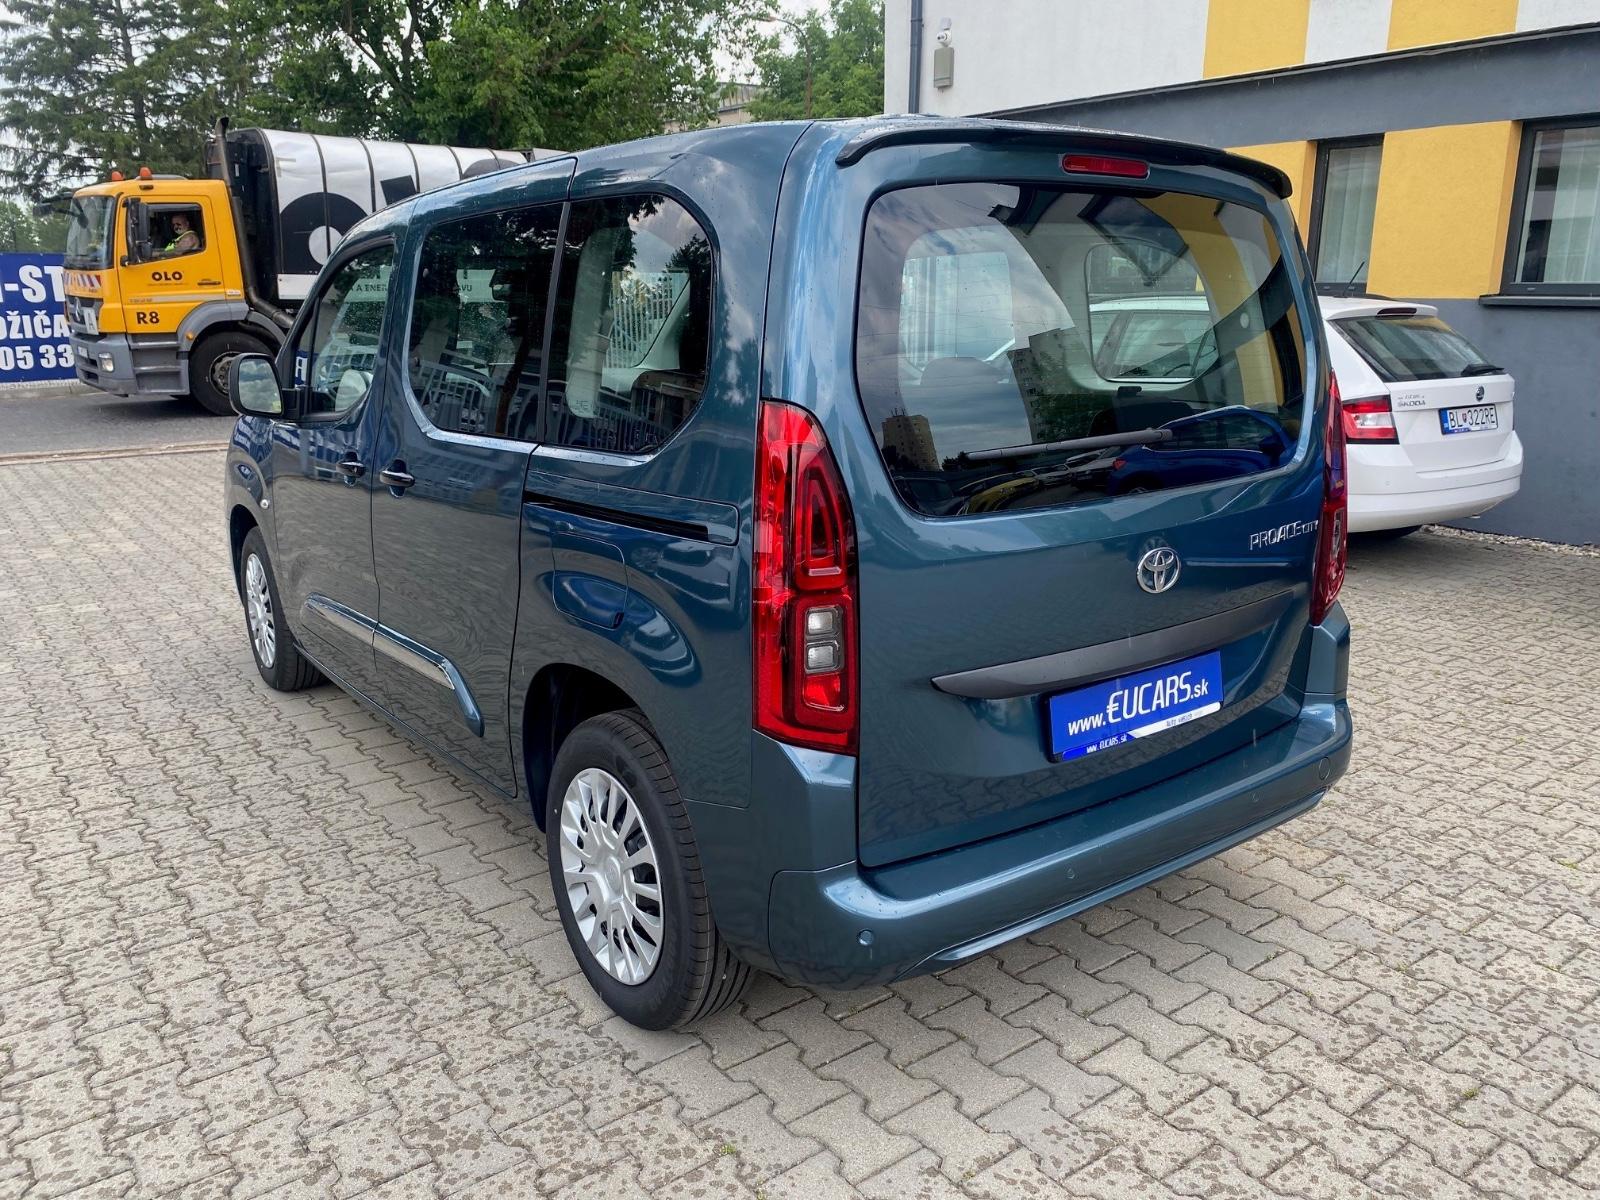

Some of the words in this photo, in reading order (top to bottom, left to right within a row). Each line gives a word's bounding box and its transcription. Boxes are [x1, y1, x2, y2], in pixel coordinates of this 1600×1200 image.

[151, 271, 183, 282] OLO
[136, 311, 160, 325] R8
[39, 344, 75, 369] 33
[1249, 520, 1301, 551] PROACE
